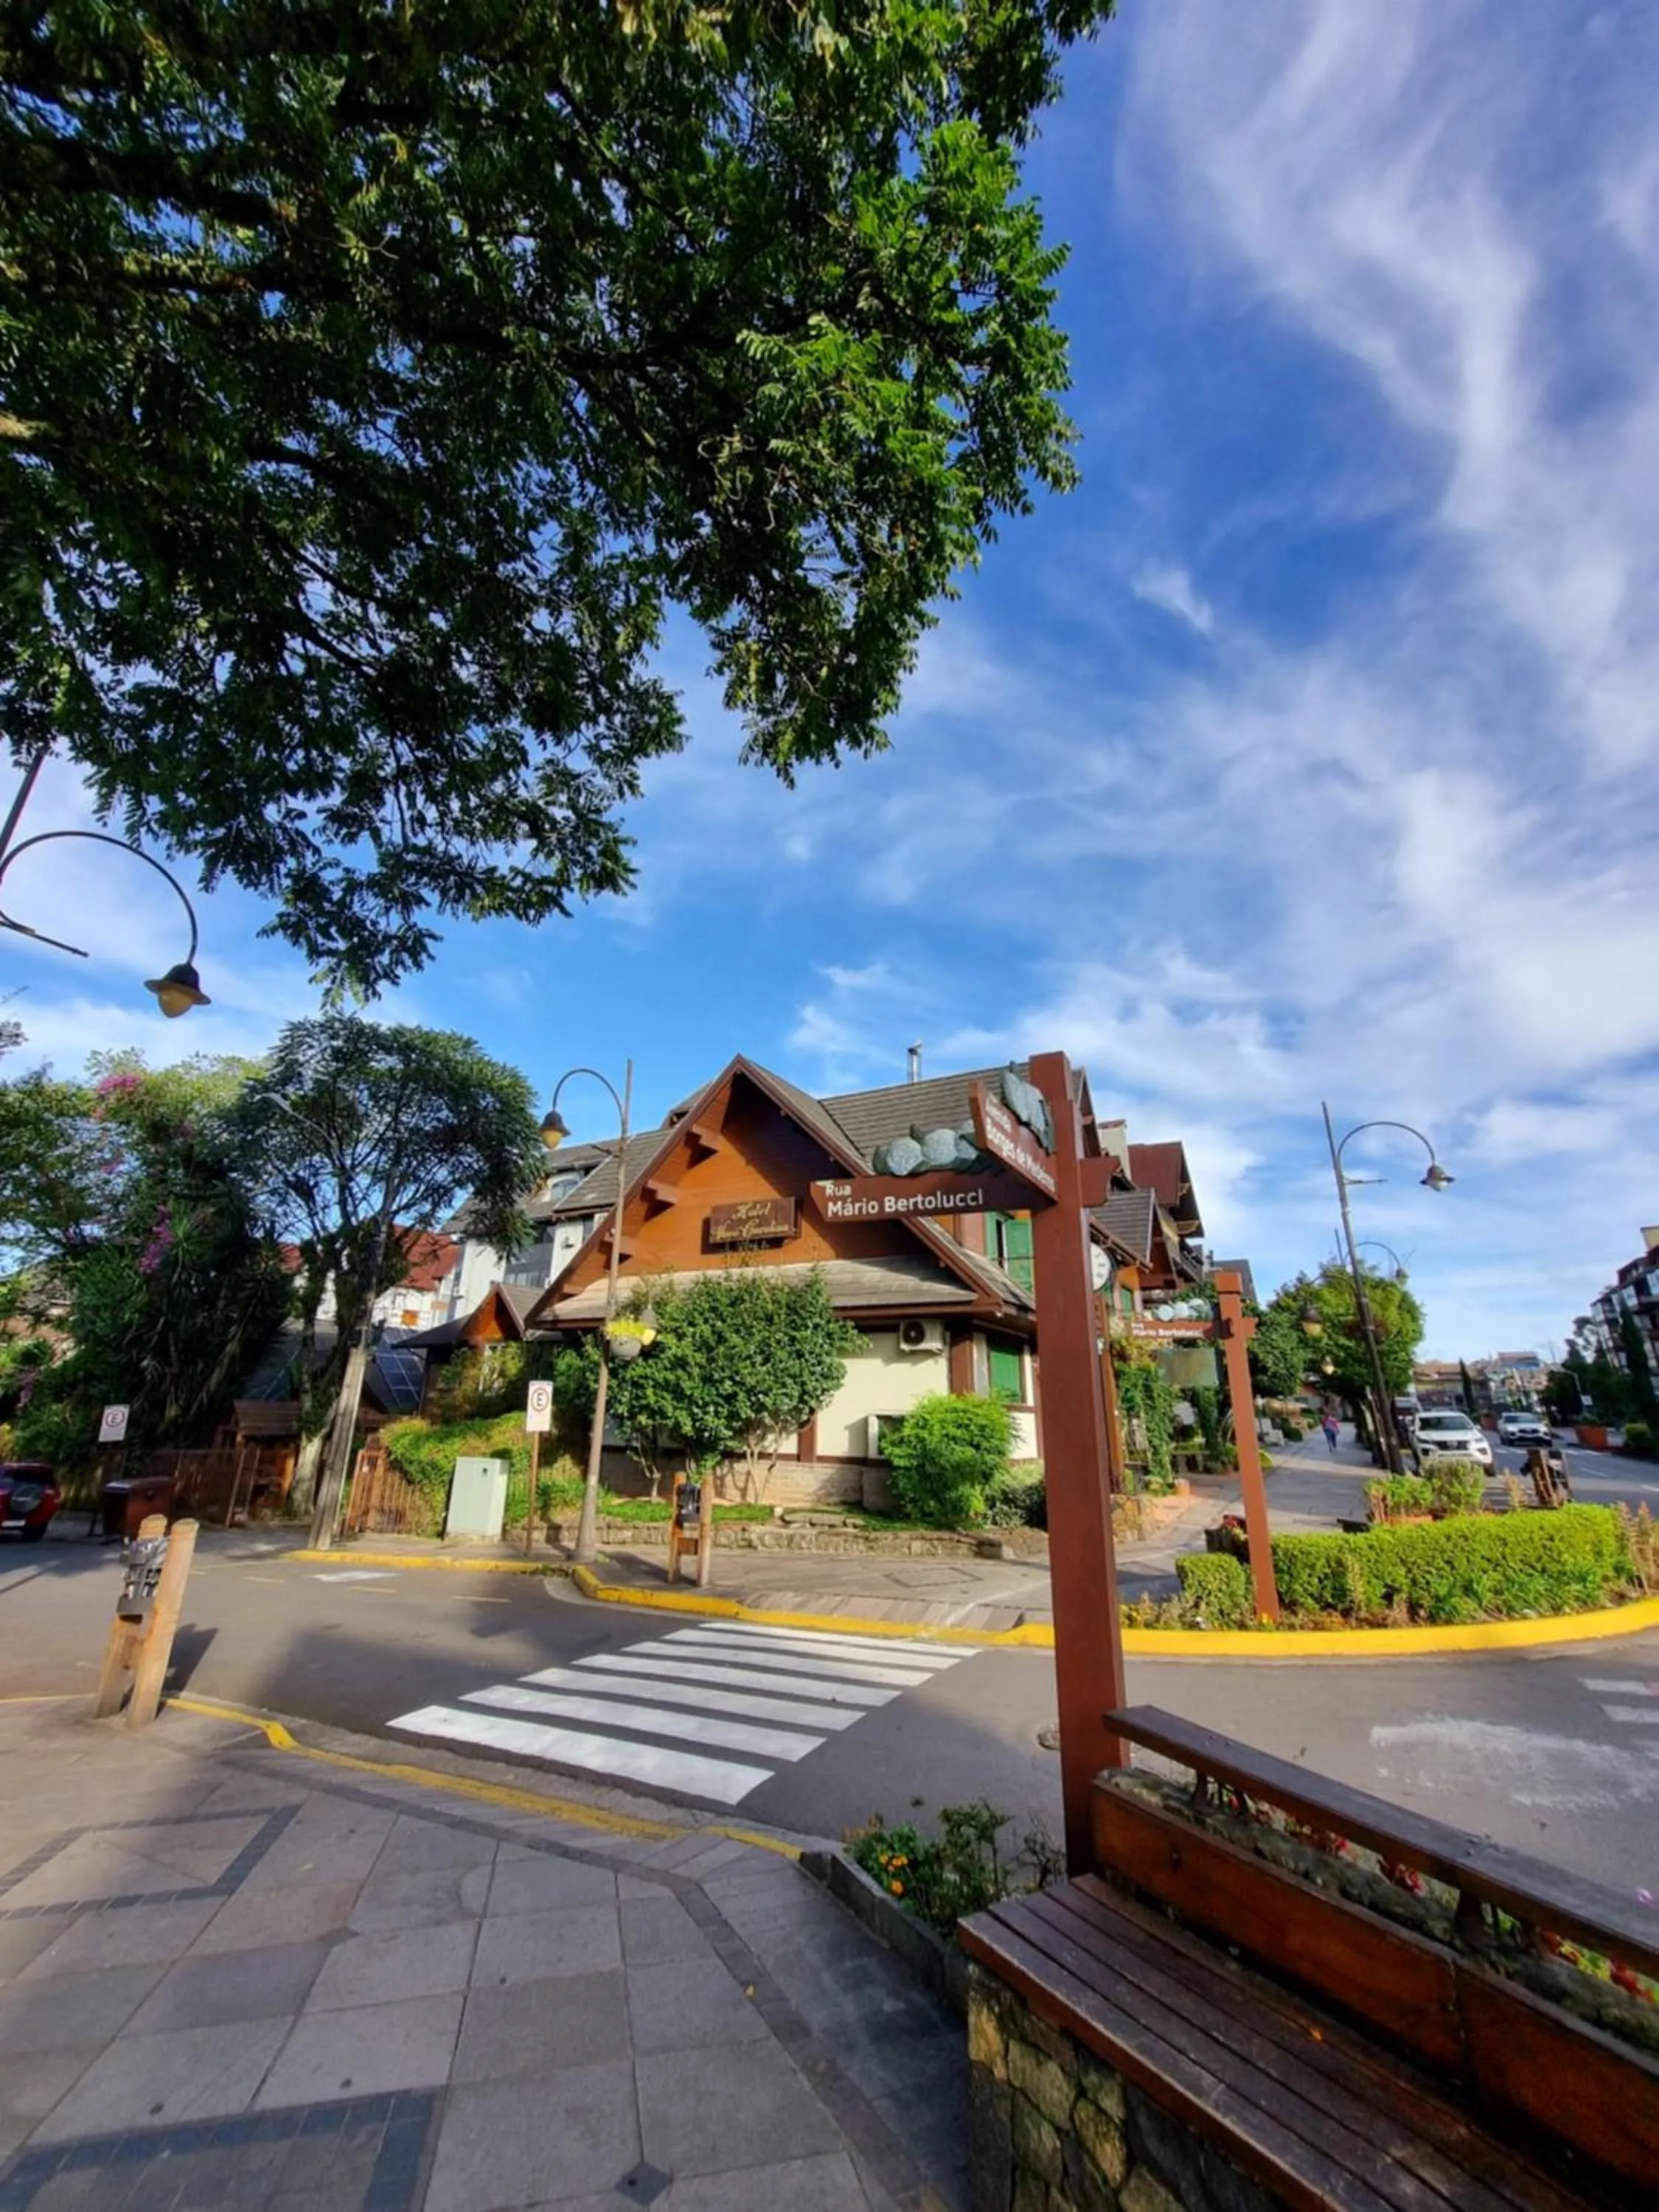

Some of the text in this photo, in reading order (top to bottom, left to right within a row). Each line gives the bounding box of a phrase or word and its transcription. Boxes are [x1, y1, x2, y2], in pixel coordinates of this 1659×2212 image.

[825, 1183, 851, 1197] Rua
[827, 1189, 983, 1217] Mário Bertolucci
[537, 1392, 543, 1407] E
[111, 1413, 119, 1424] E
